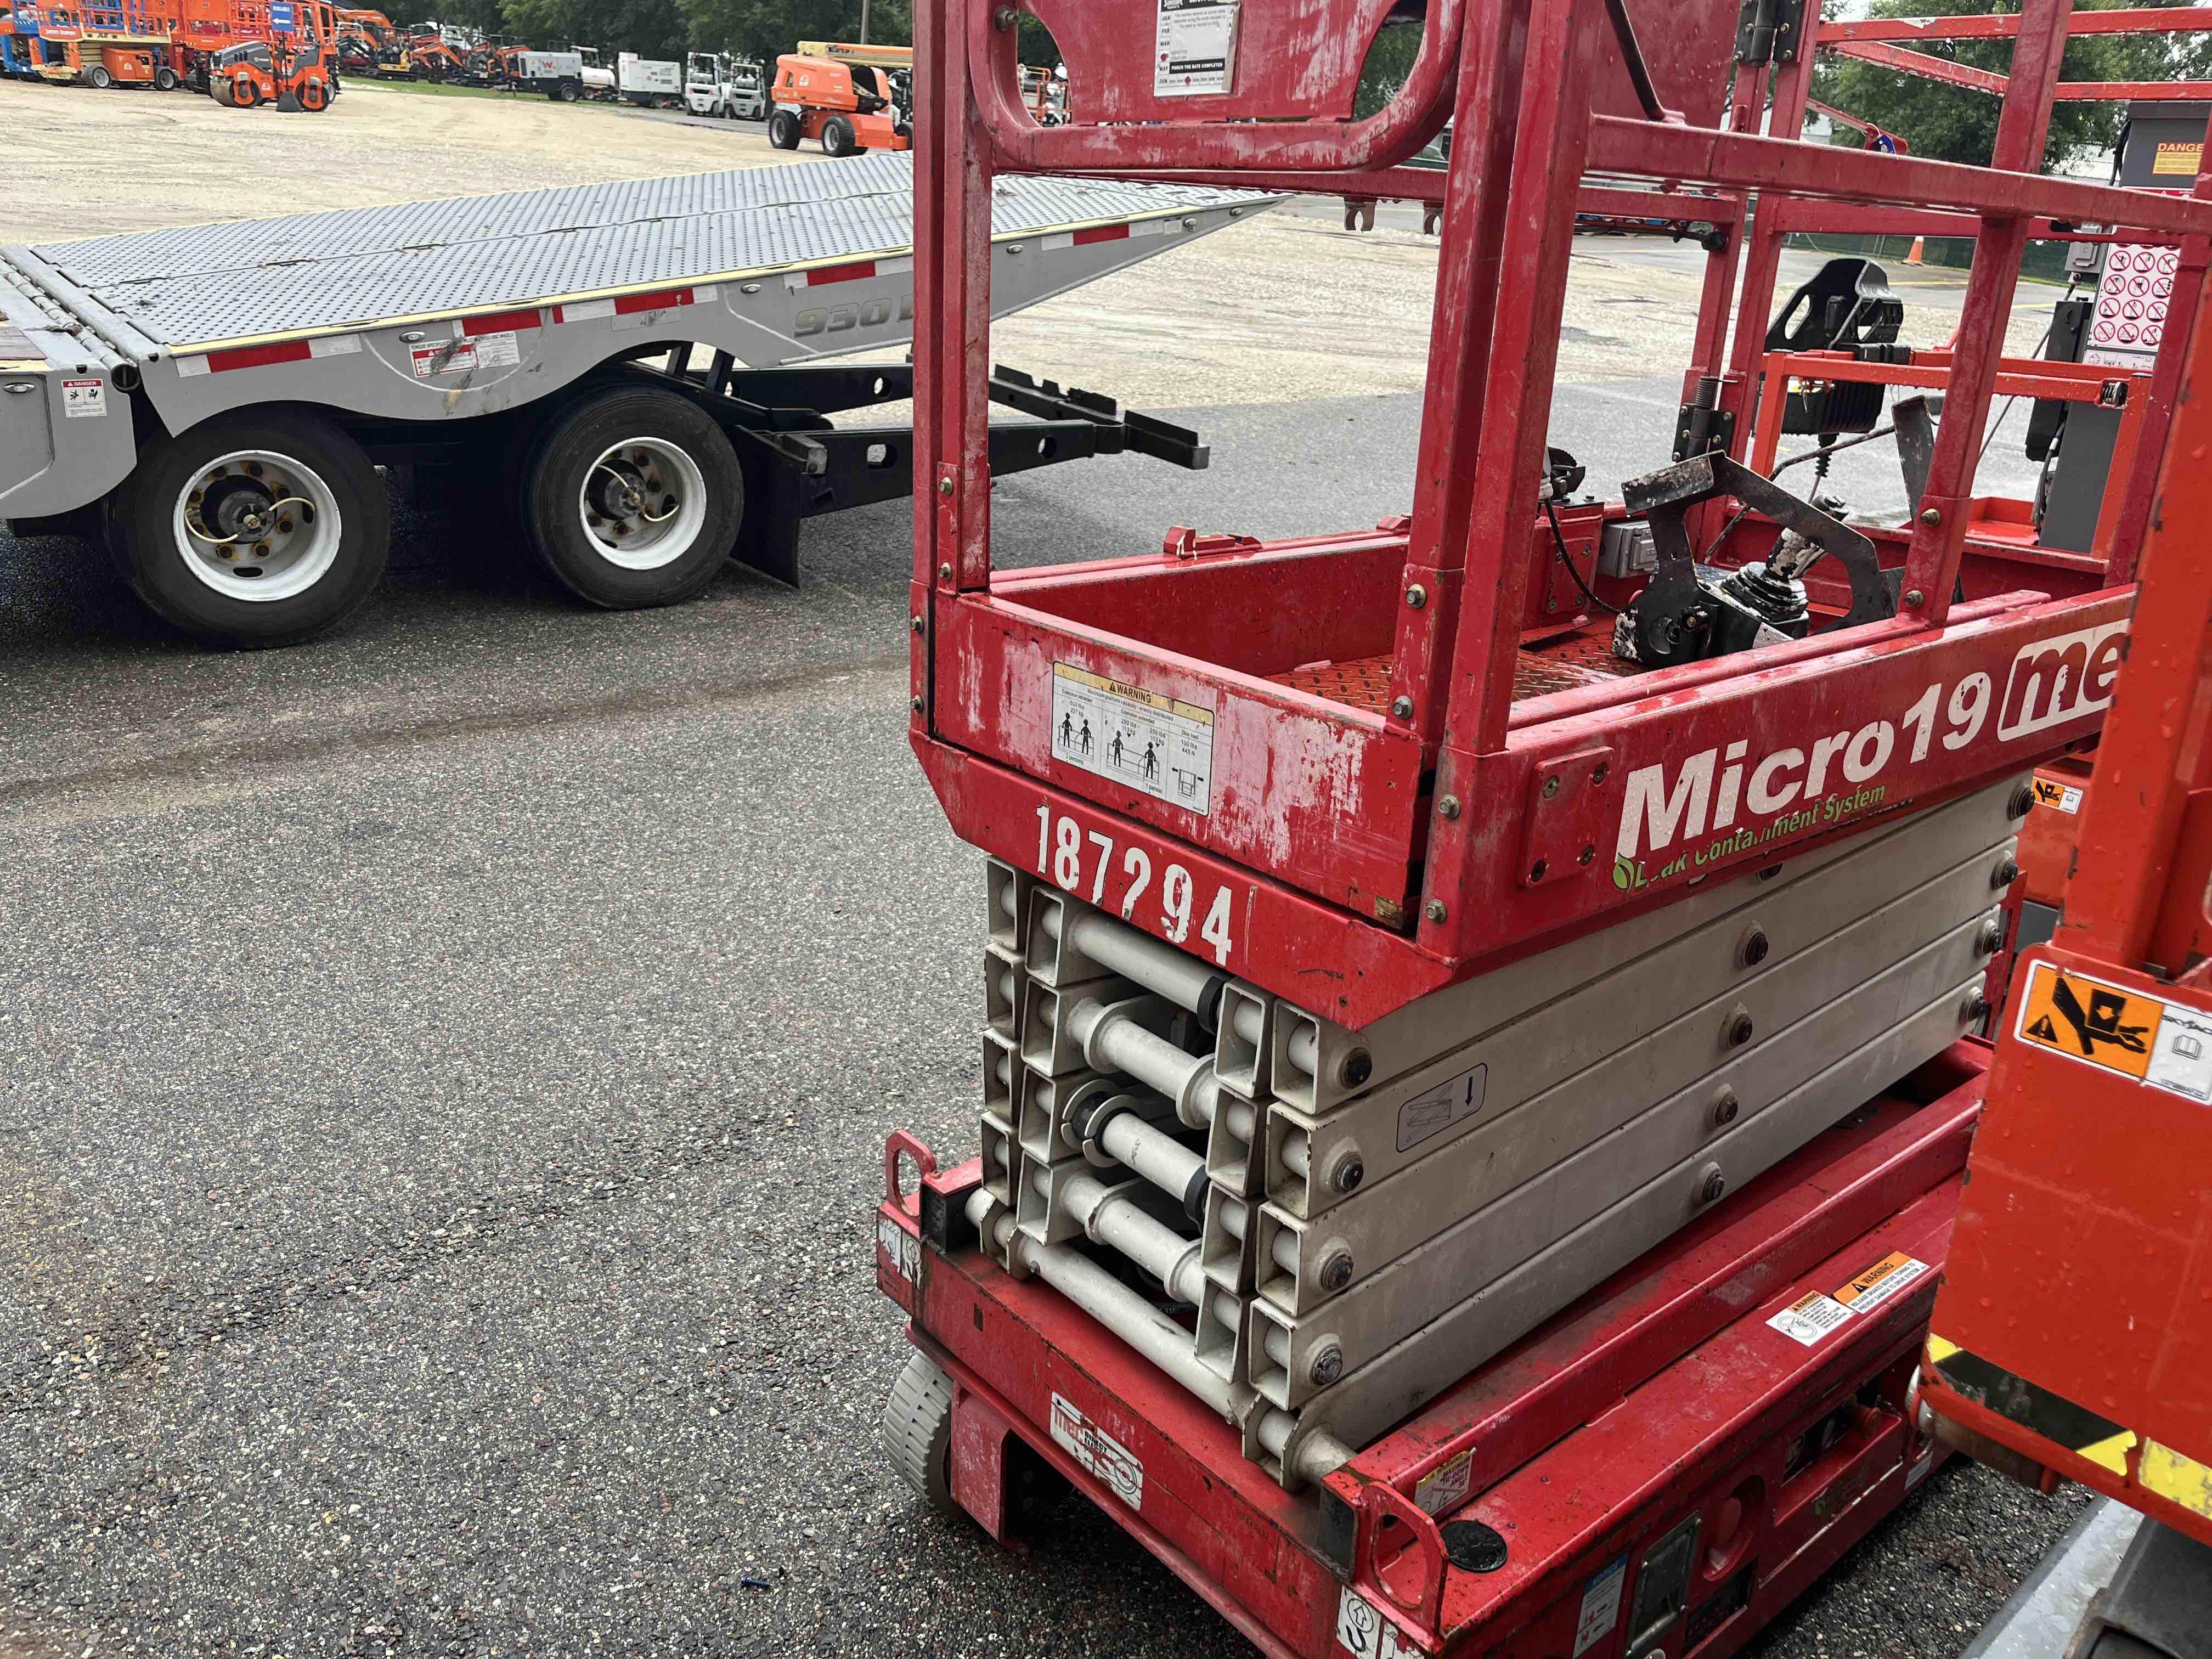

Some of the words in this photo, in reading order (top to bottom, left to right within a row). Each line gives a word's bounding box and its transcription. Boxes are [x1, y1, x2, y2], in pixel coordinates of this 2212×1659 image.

[2158, 143, 2203, 151] DANGE
[2000, 632, 2131, 731] me
[1118, 684, 1151, 703] WARNING
[1182, 747, 1190, 755] 445
[1149, 785, 1163, 794] person
[1824, 785, 1886, 822] System
[1036, 804, 1232, 966] 187294
[1860, 1262, 1895, 1284] WARNING
[1797, 1292, 1820, 1307] WARNING
